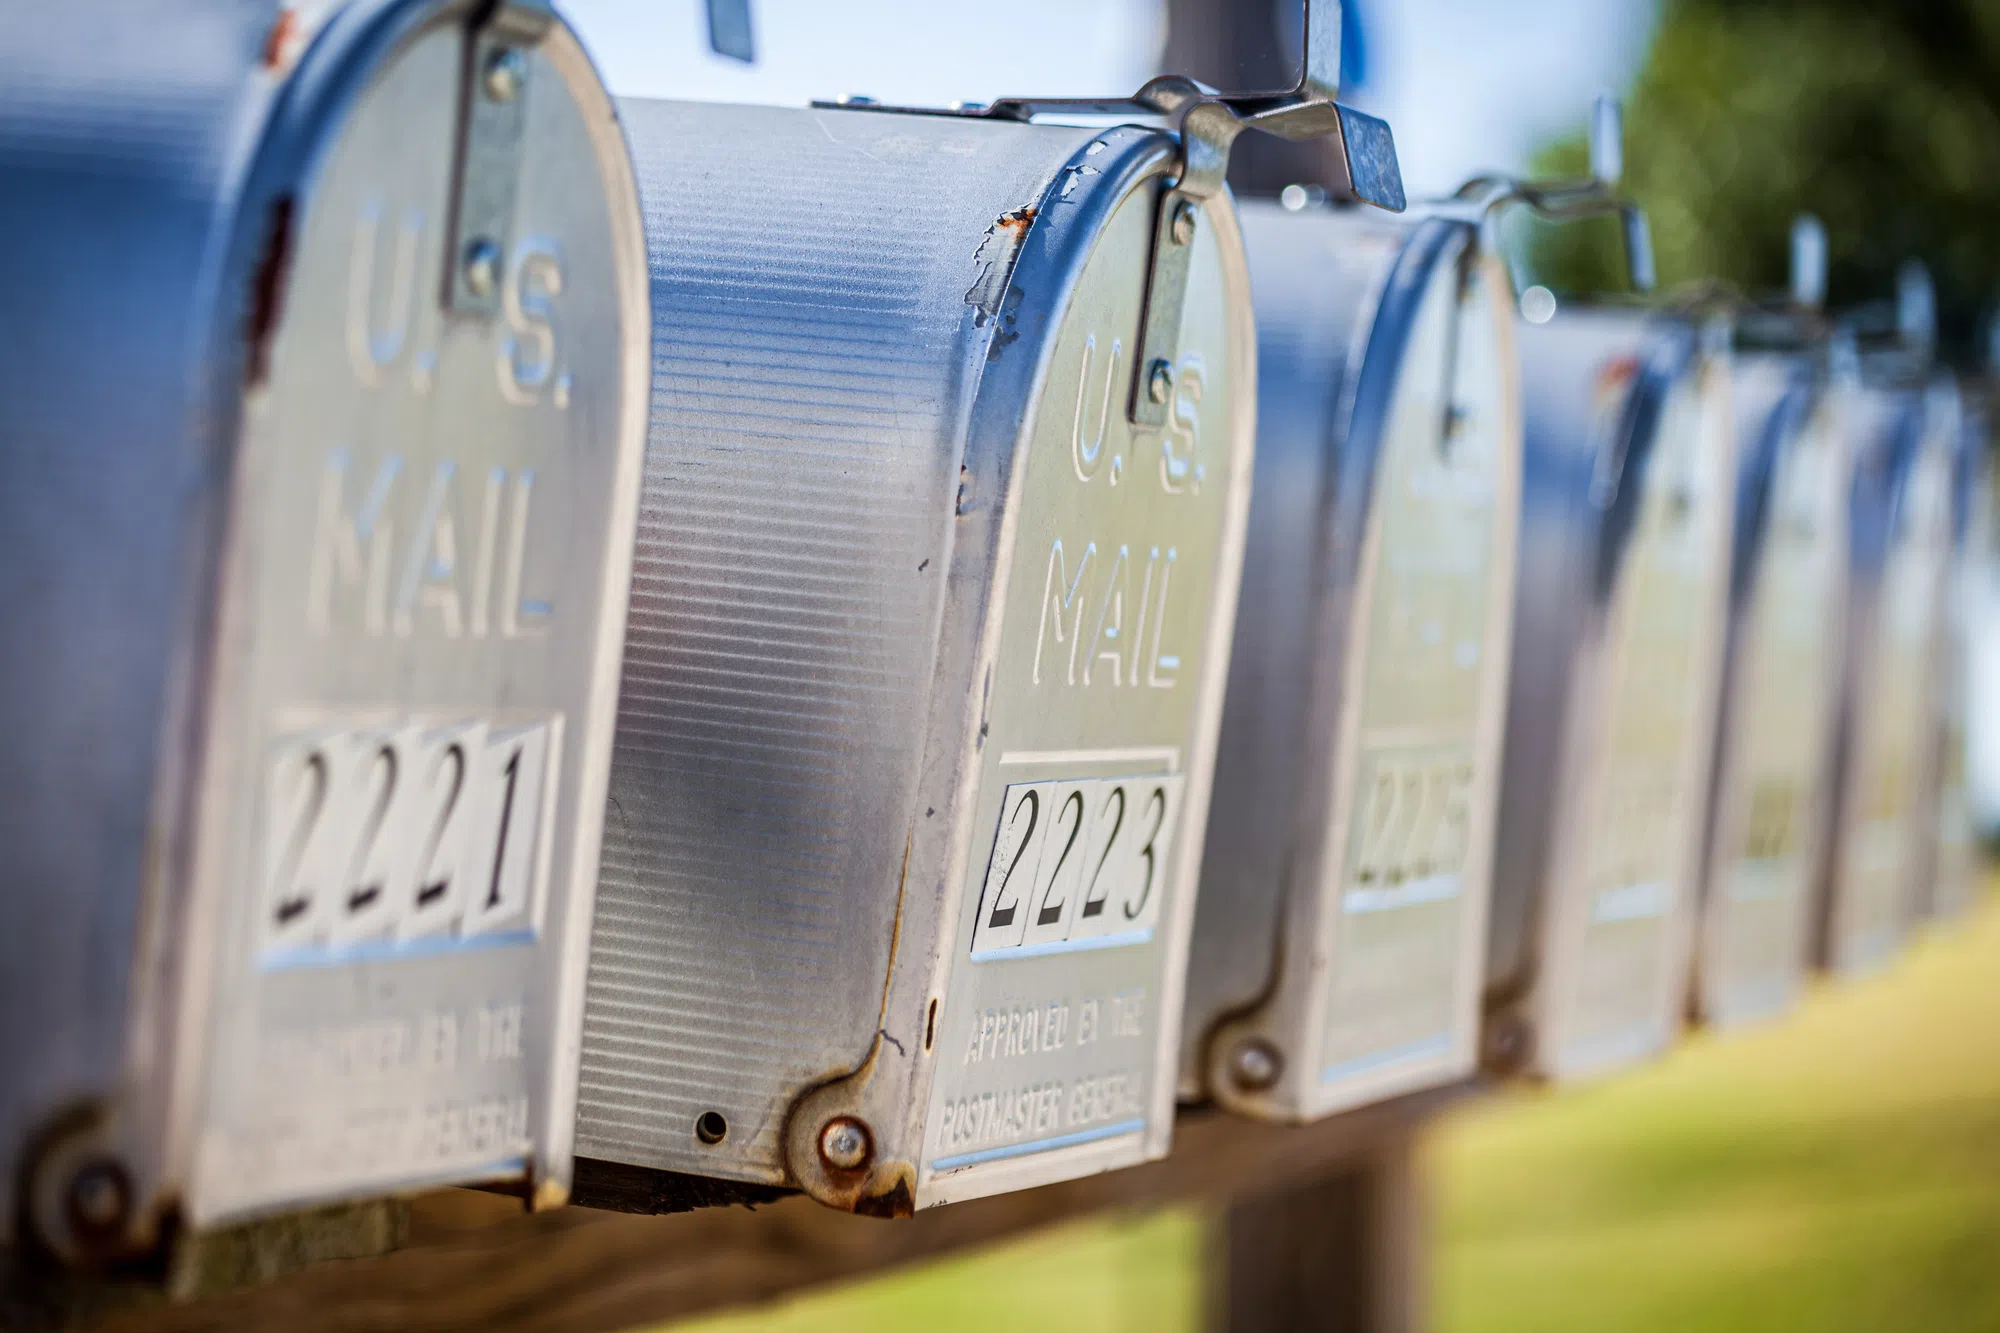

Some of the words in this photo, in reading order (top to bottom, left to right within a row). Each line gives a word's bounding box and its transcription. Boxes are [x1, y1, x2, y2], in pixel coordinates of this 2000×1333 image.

[345, 205, 437, 395] U.
[498, 235, 572, 411] S.
[1072, 334, 1121, 486] U.
[1160, 351, 1206, 495] S.
[304, 449, 553, 639] MAIL
[1032, 538, 1180, 688] MAIL
[273, 741, 524, 928] 2221
[988, 786, 1166, 928] 2223
[964, 1003, 1069, 1066] APPROVED
[934, 1080, 1064, 1149] POSTMASTER
